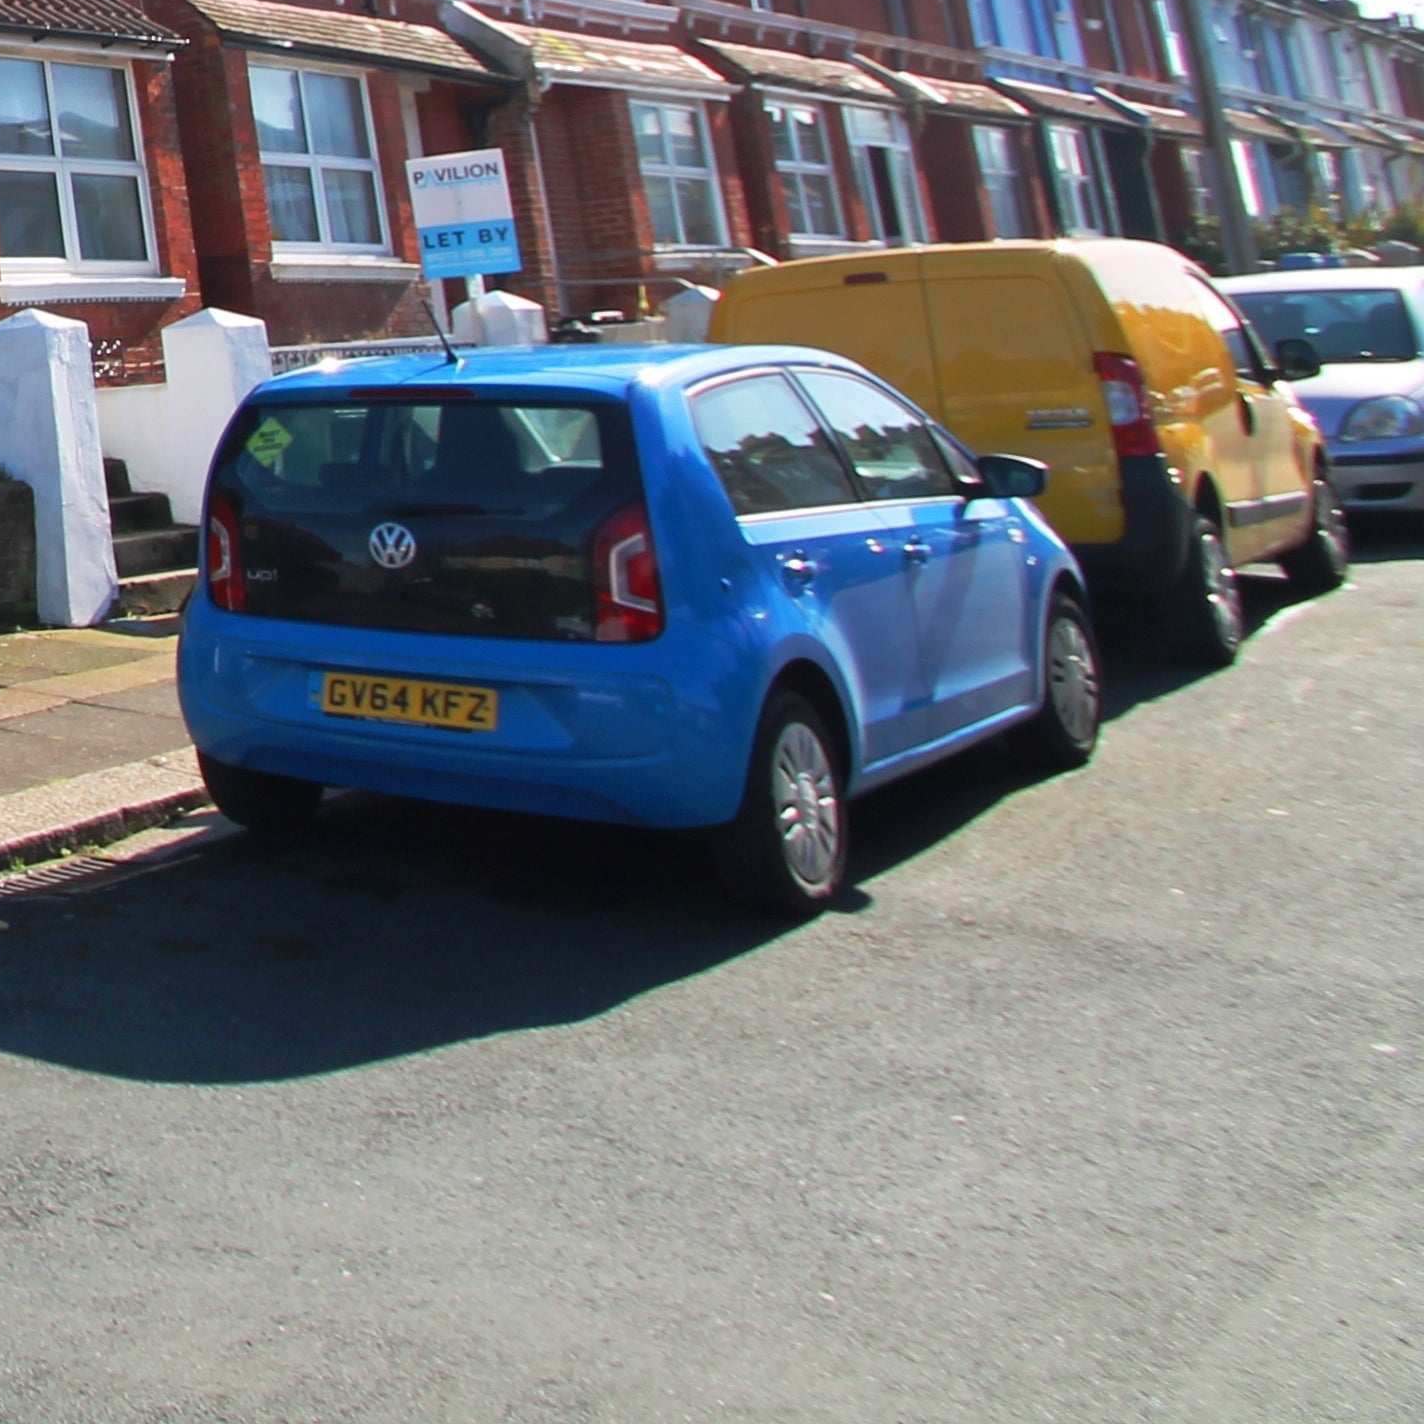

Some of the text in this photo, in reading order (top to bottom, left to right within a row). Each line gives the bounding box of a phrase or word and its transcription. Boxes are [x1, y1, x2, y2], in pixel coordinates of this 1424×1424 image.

[423, 227, 509, 249] LET BY
[328, 678, 489, 723] GV64 KFZ
